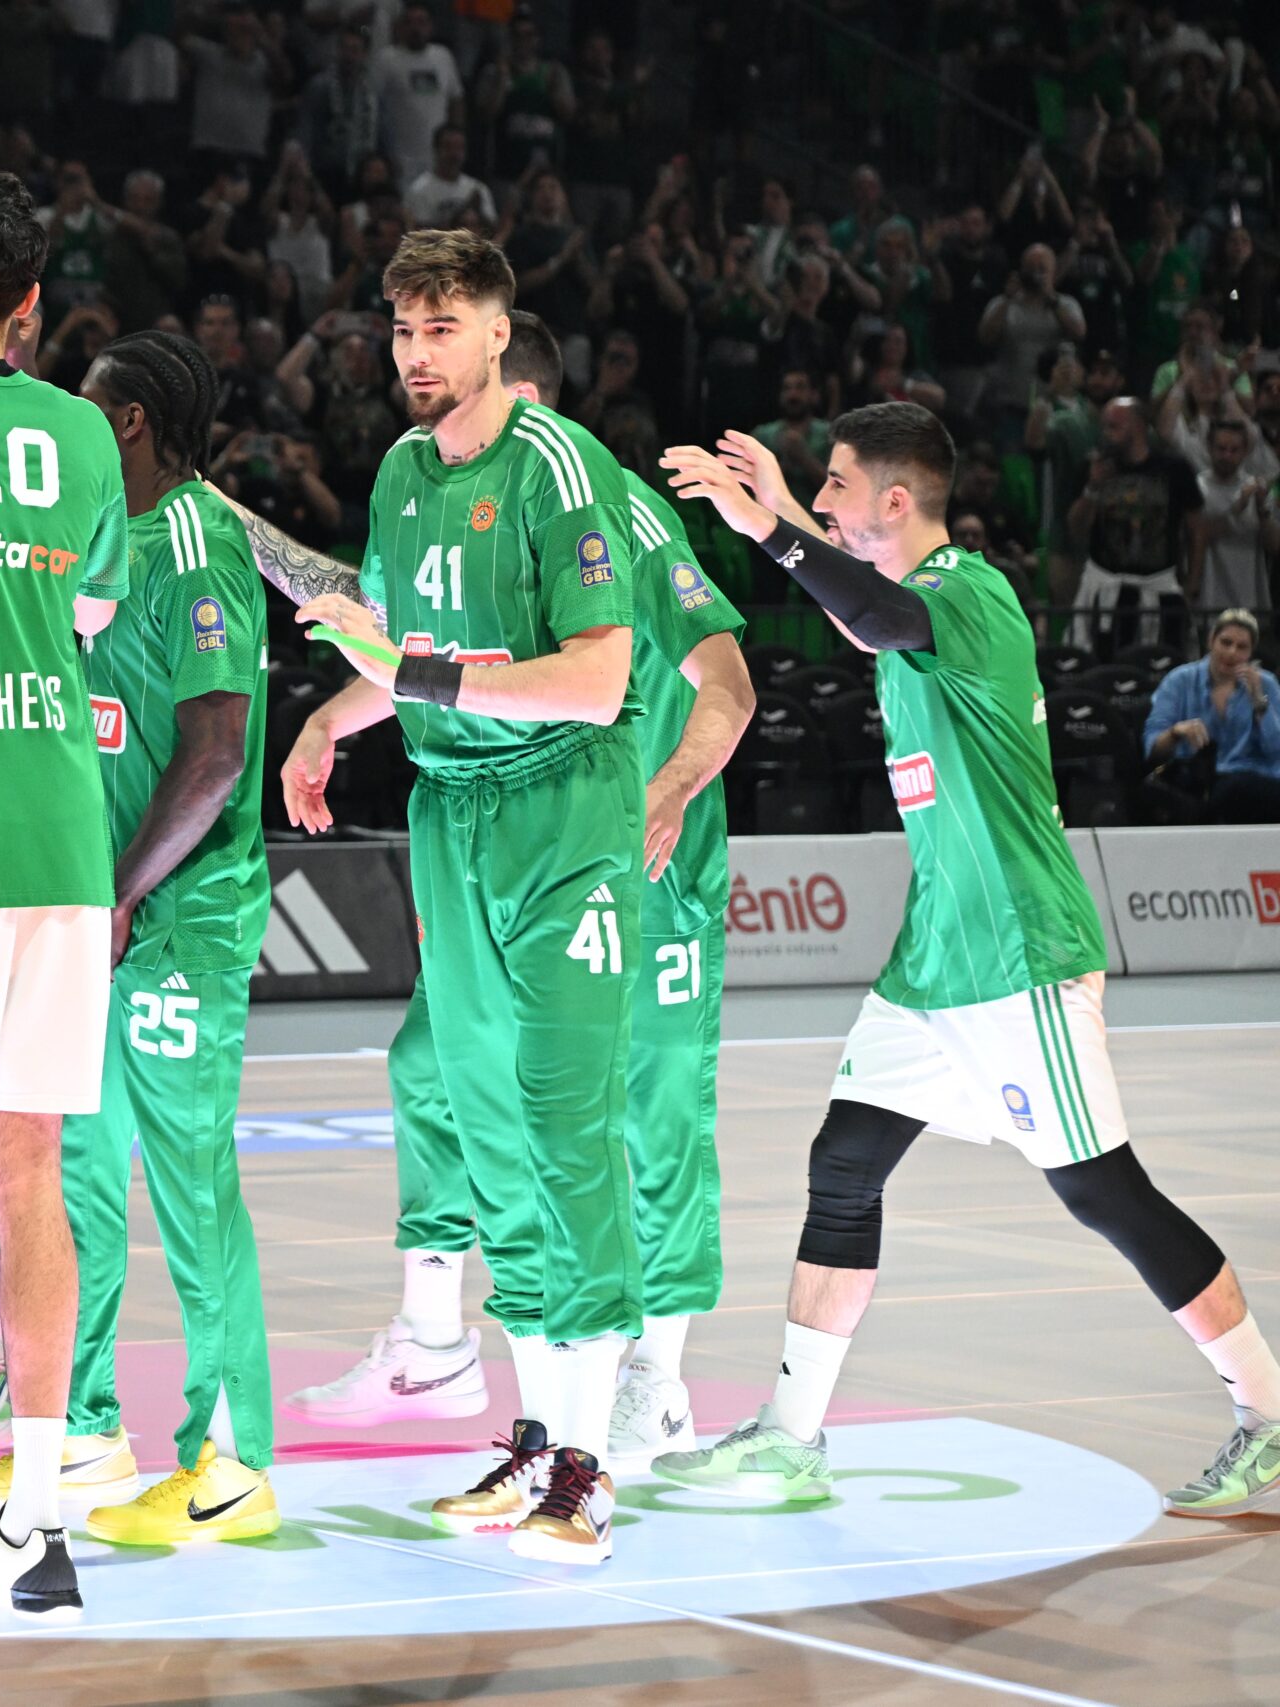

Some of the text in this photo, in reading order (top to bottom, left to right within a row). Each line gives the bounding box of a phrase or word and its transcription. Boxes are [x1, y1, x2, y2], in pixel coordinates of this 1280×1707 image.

[413, 544, 463, 610] 41
[582, 569, 612, 585] GBL
[683, 593, 713, 611] GBL
[197, 635, 225, 651] GBL
[1128, 878, 1280, 922] ecommb
[565, 909, 623, 974] 41
[655, 939, 701, 1006] 21
[129, 991, 200, 1059] 25
